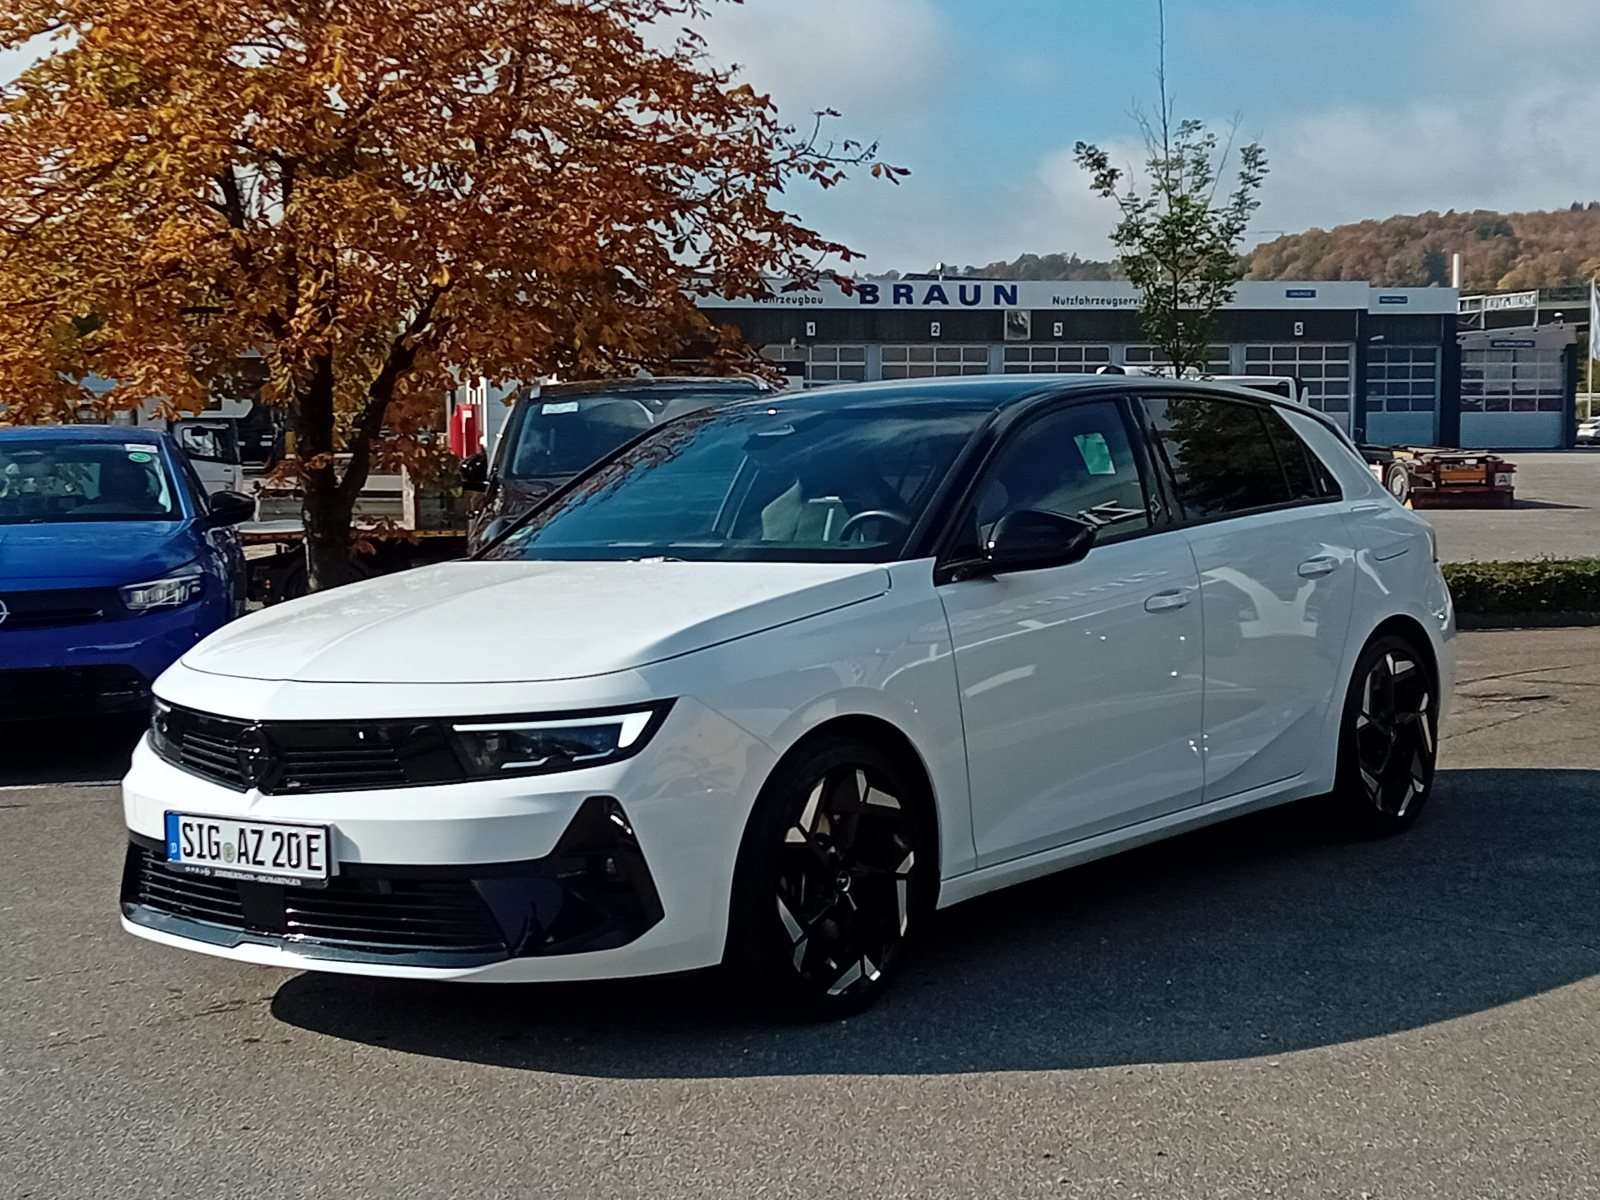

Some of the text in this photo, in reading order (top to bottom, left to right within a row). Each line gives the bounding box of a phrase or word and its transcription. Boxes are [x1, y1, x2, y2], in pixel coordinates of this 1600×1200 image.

[753, 294, 824, 306] ahrzeugbau
[859, 283, 1018, 306] BRAUN
[182, 822, 322, 871] SIG AZ 20E
